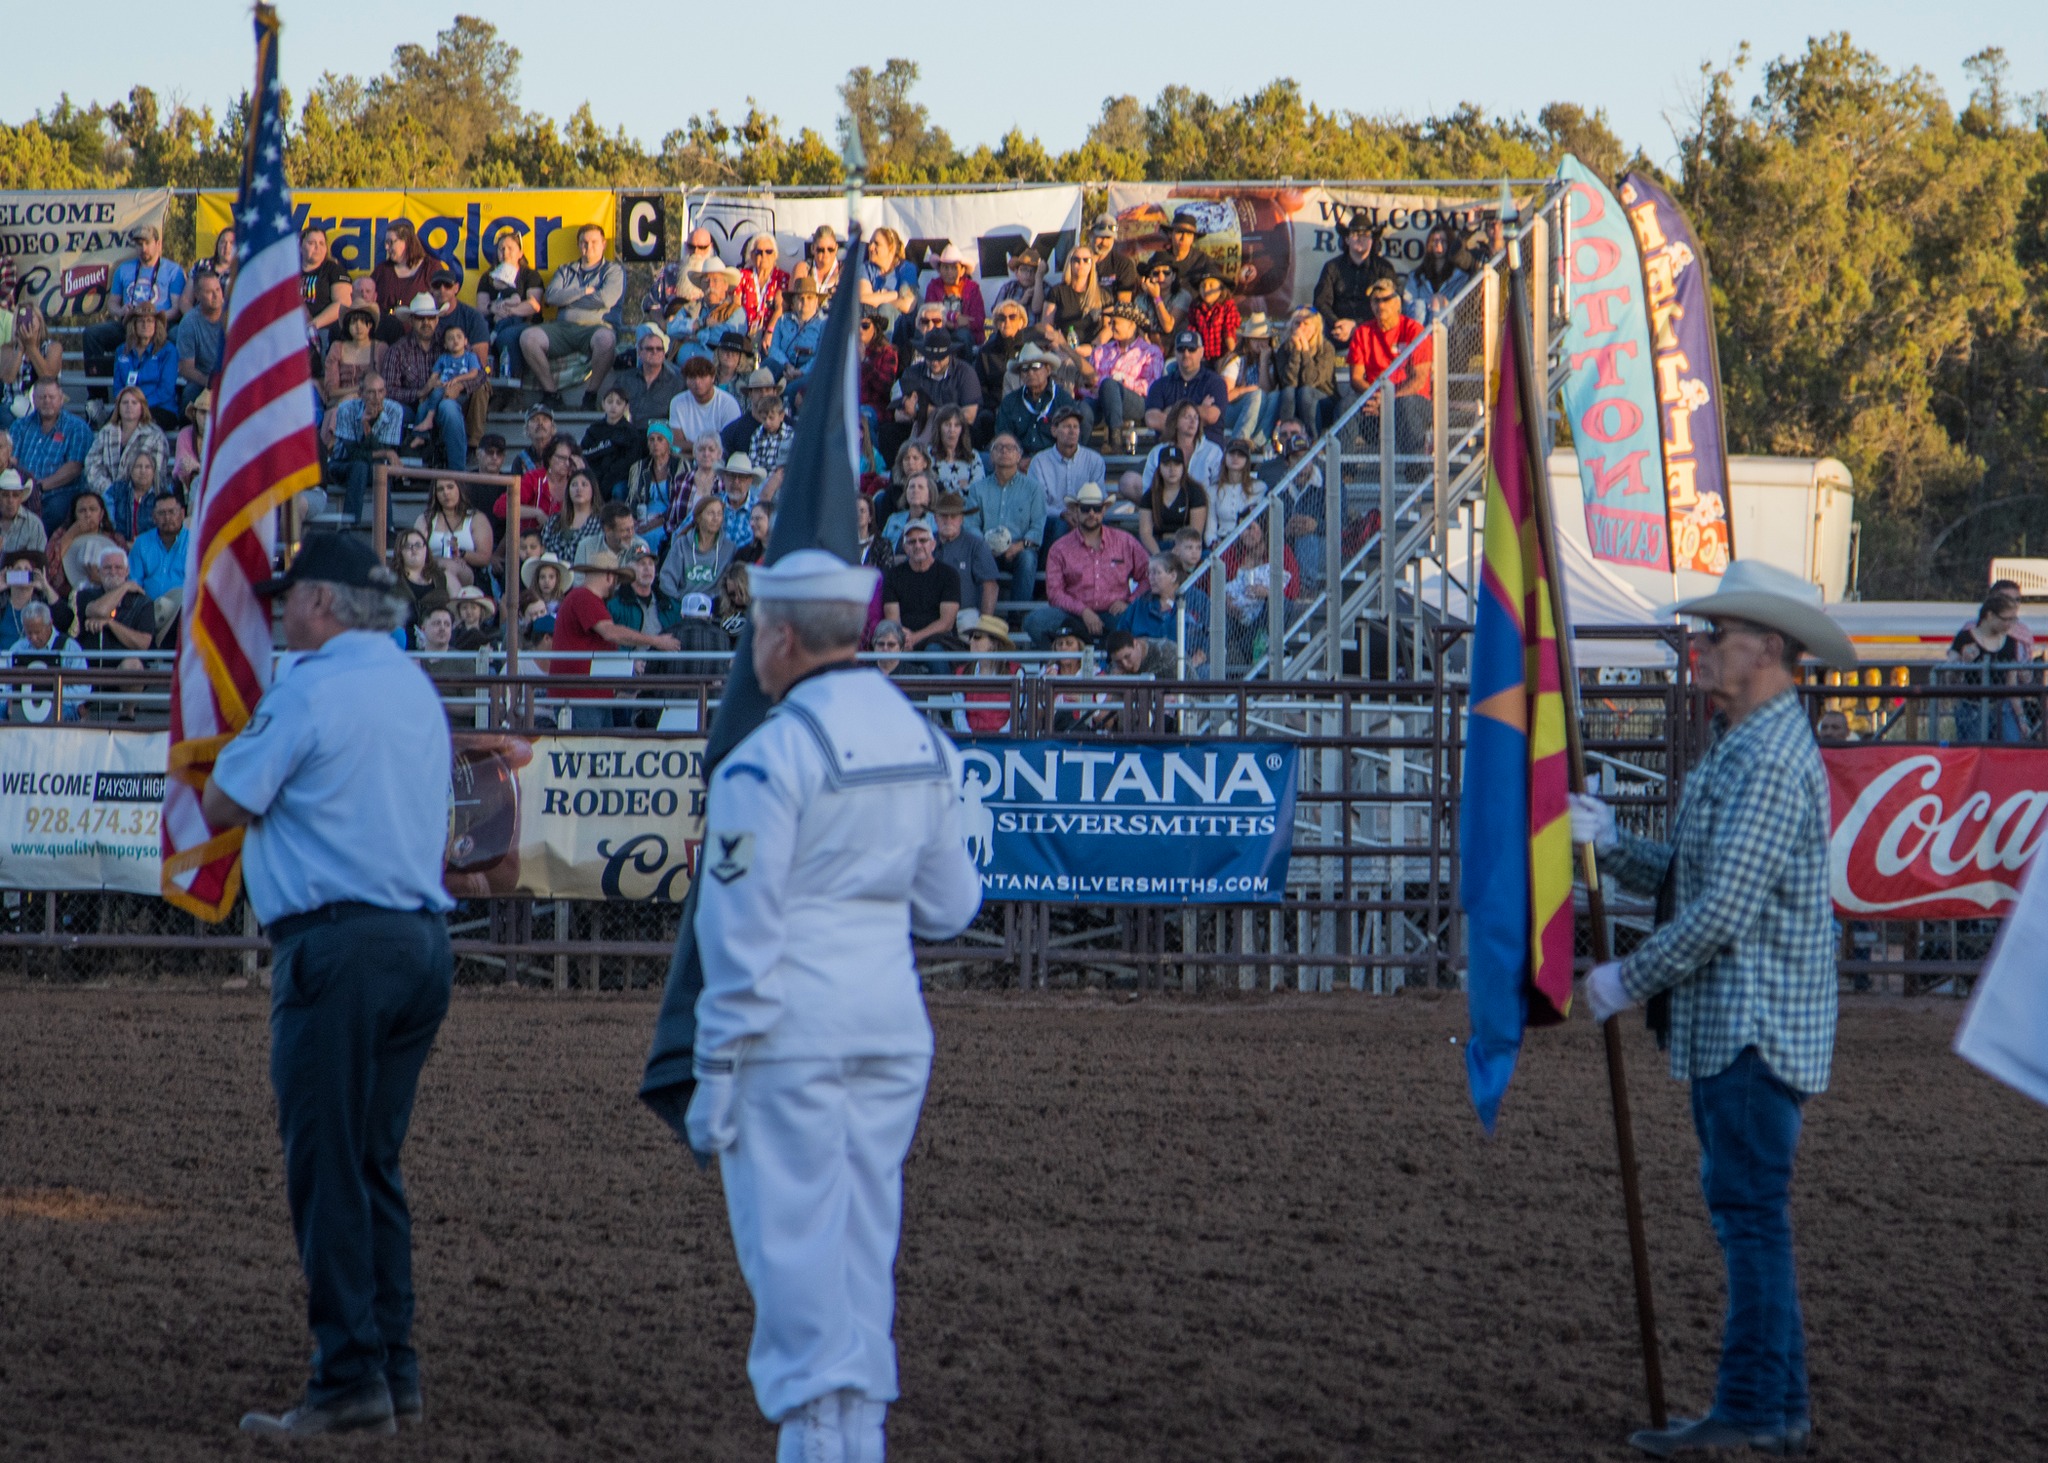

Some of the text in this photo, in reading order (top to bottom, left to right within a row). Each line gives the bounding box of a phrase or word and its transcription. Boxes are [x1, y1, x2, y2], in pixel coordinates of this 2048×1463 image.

[0, 202, 115, 226] LCOME
[0, 231, 60, 255] DEO
[626, 201, 658, 257] C
[230, 202, 562, 294] rangler
[64, 266, 106, 295] Banquet
[548, 750, 706, 779] WELCO
[955, 748, 1276, 803] ONTANA
[2, 772, 167, 798] WELCOME PAYSON HIGH
[541, 787, 679, 817] RODEO
[26, 807, 159, 836] 928.474.32
[997, 812, 1276, 837] SILVERSMITHS
[1829, 754, 2048, 913] Coca
[979, 873, 1269, 893] NTANASILVERSMITHS.COM
